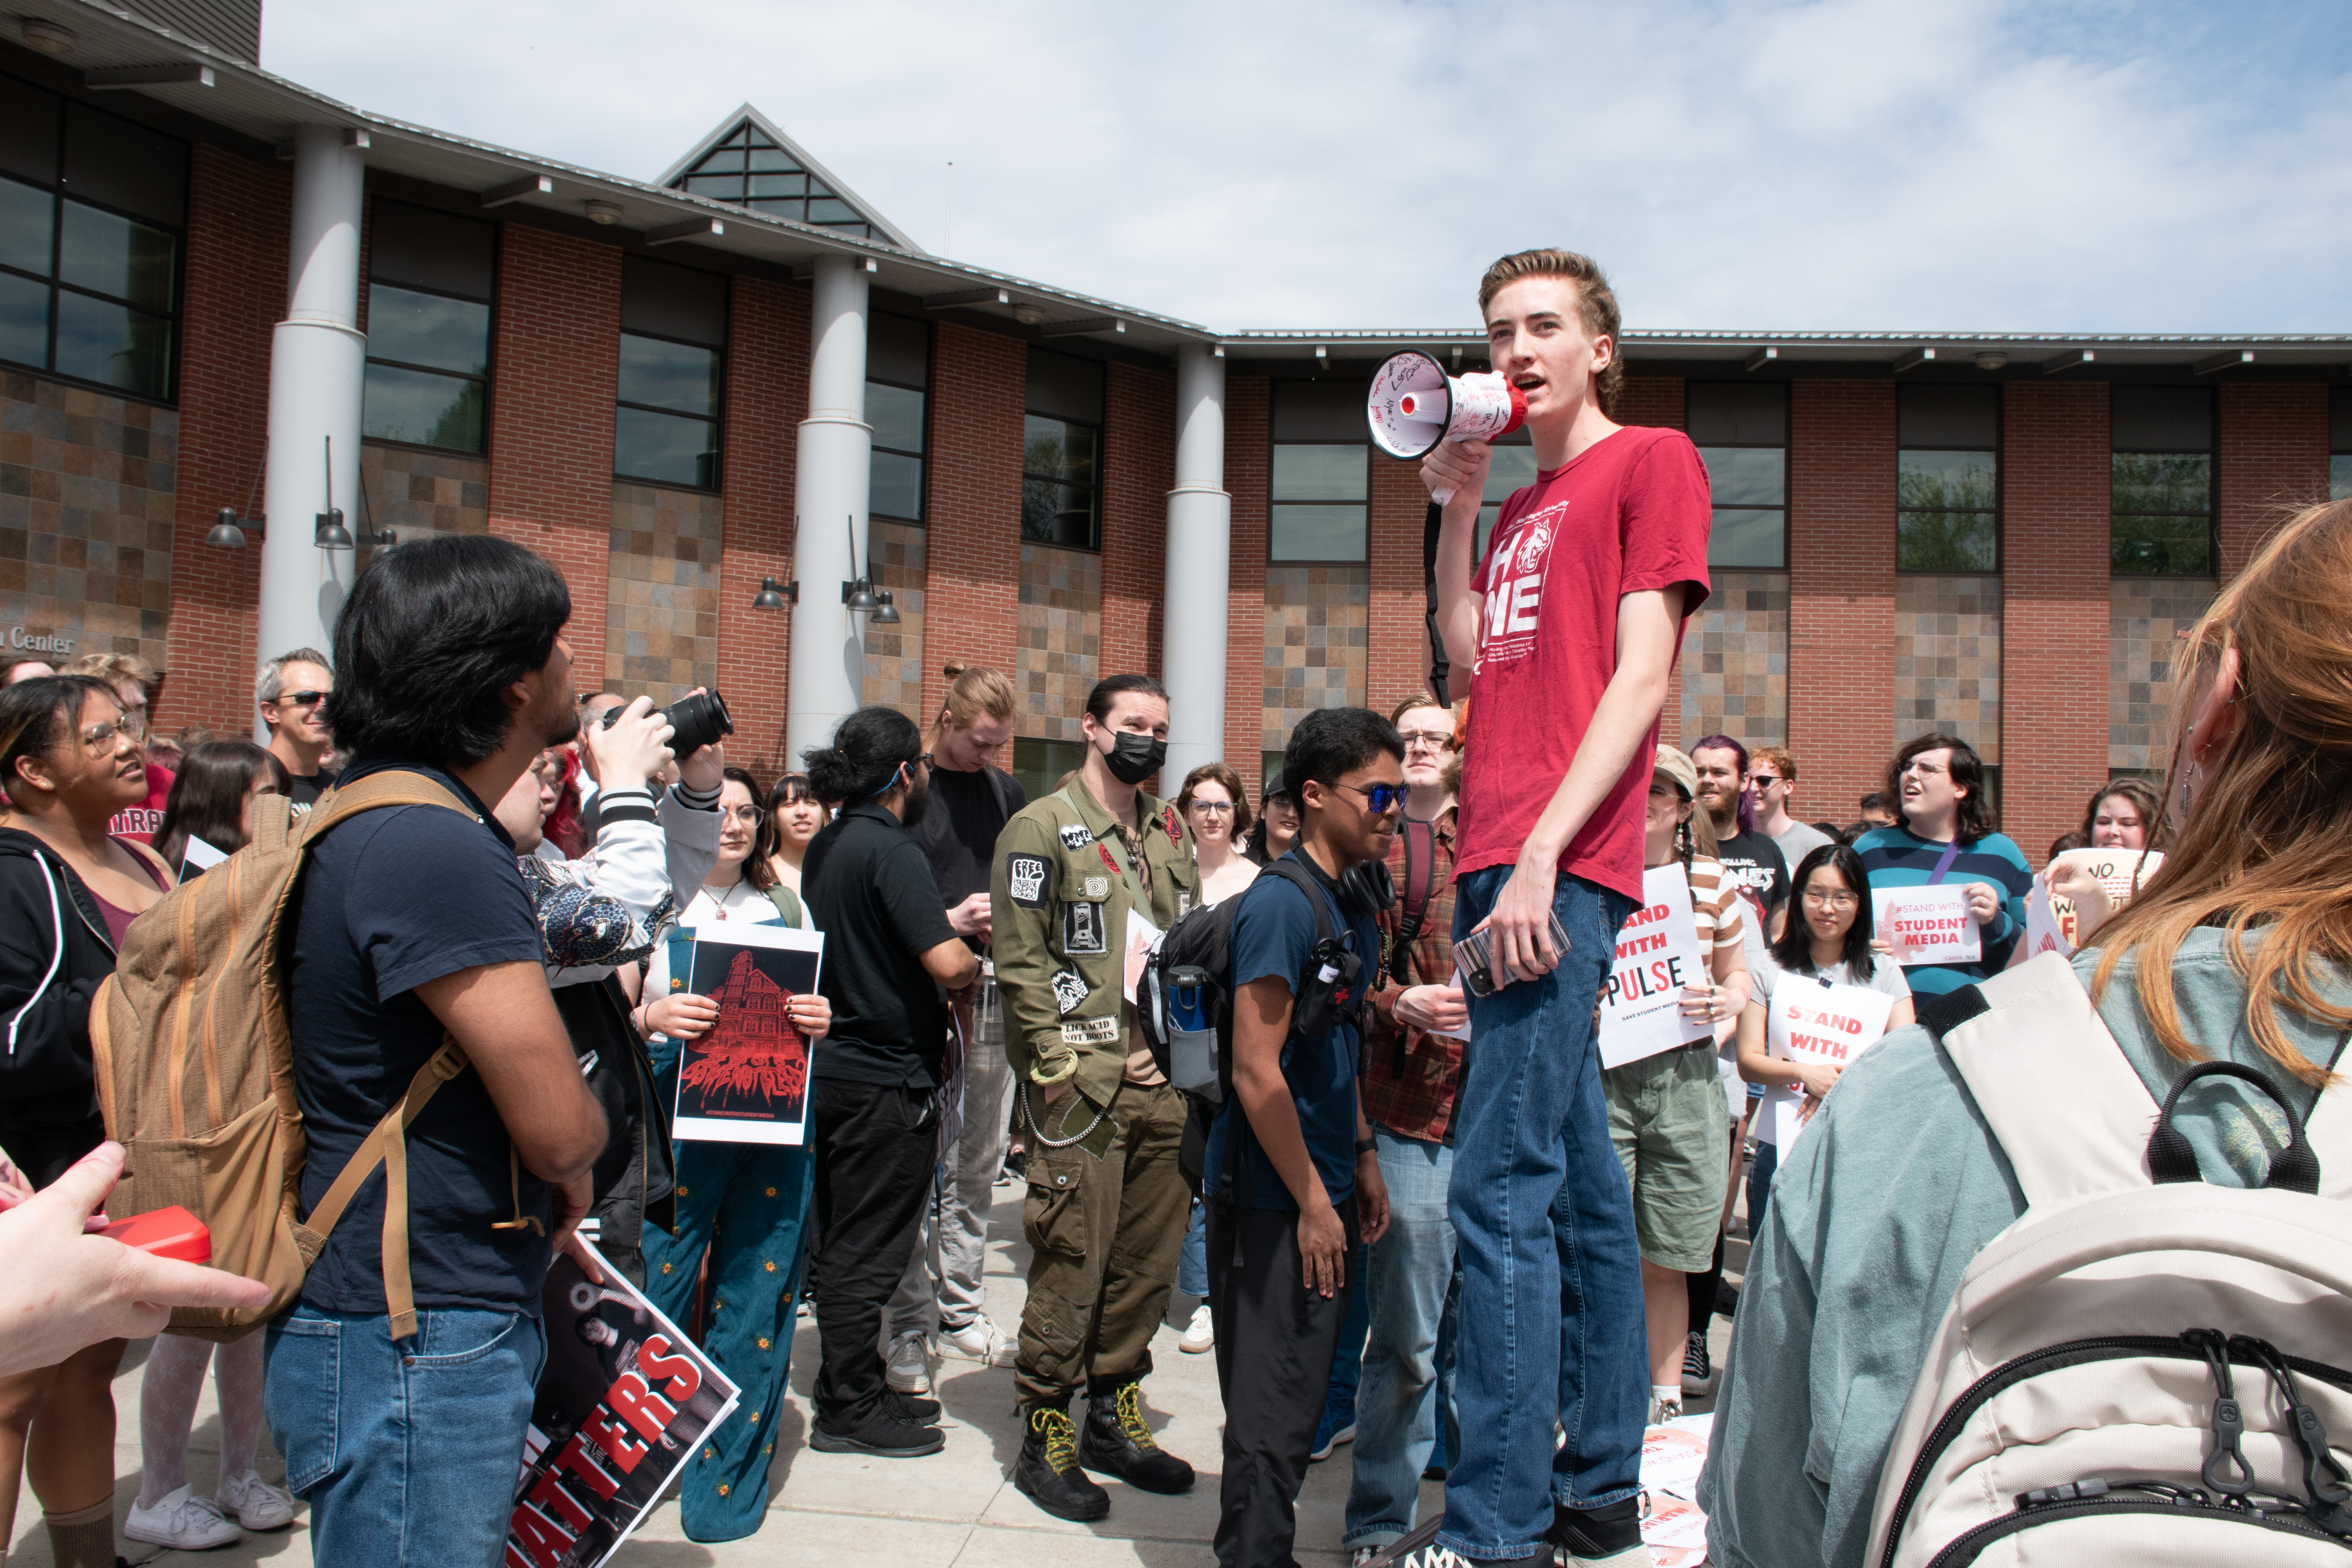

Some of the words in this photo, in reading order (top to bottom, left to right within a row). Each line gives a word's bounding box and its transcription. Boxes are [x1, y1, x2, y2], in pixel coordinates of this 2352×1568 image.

[11, 627, 74, 653] Center
[1015, 860, 1041, 878] FREE
[1896, 904, 1935, 914] #STAND
[1938, 902, 1964, 912] WITH
[1895, 917, 1967, 933] STUDENT
[1904, 933, 1959, 946] MEDIA
[1608, 956, 1685, 1006] PULSE
[1622, 1011, 1637, 1021] SAVE
[1637, 1005, 1662, 1018] STUDENT
[1663, 1000, 1679, 1011] MEDIA
[1066, 1023, 1087, 1033] LICK
[1089, 1020, 1110, 1031] ACID
[1787, 1005, 1862, 1034] STAND
[1086, 1030, 1114, 1041] BOOTS
[1790, 1032, 1848, 1060] WITH
[706, 1110, 775, 1118] #STANDWITHSTUDENTMEDIA
[1659, 1449, 1703, 1462] #STAND
